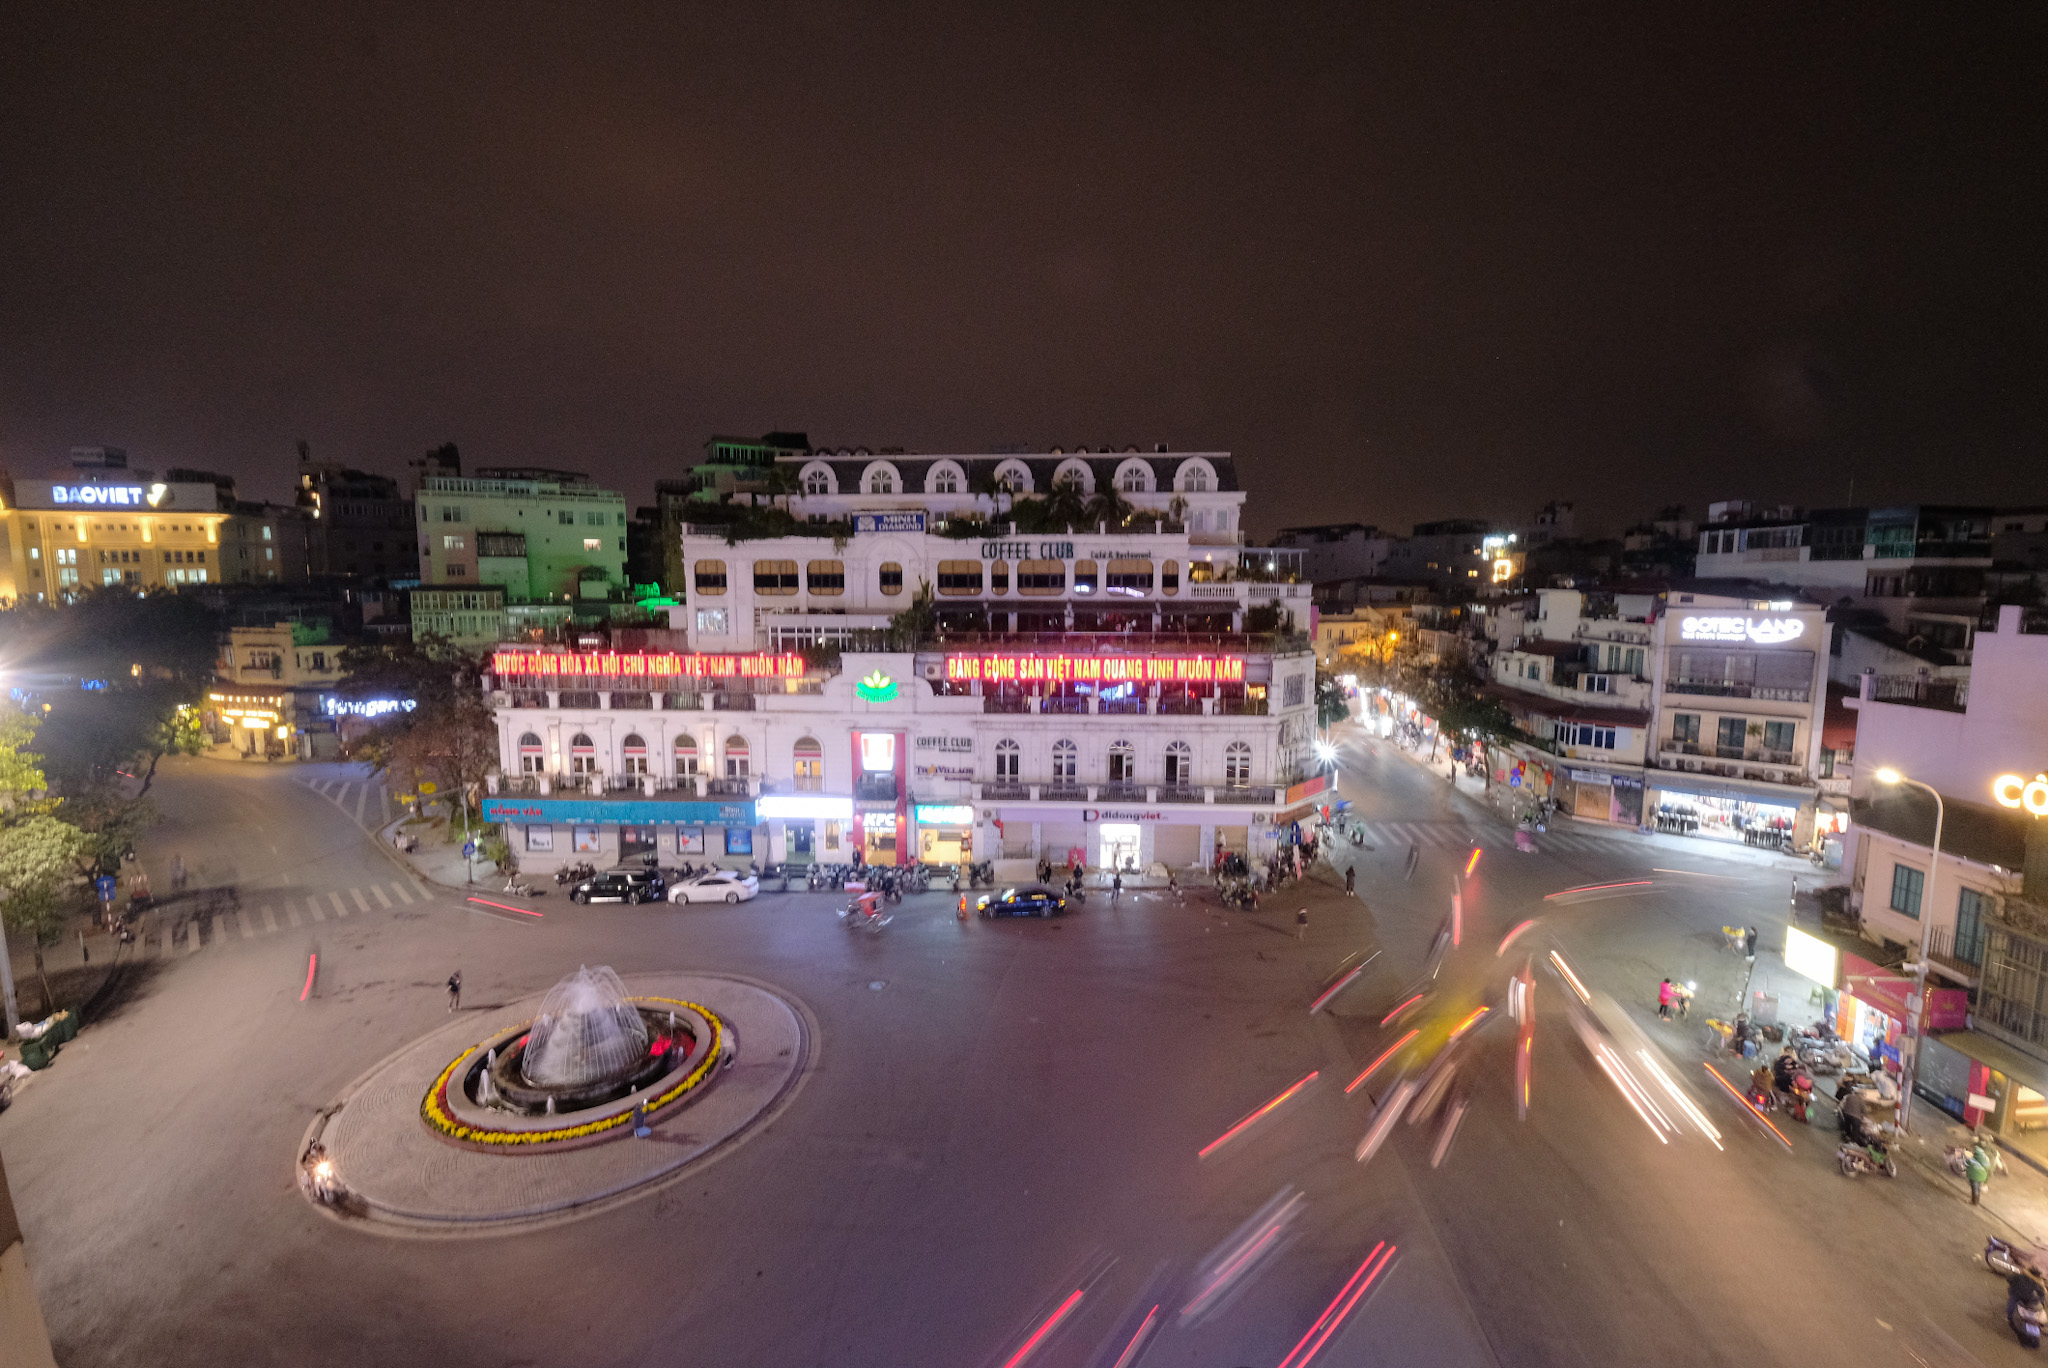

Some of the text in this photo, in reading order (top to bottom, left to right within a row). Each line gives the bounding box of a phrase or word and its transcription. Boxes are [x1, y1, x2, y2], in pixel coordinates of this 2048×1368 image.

[52, 485, 142, 504] BAOVIET
[879, 523, 921, 531] DIAMOND
[883, 515, 917, 523] MINH
[981, 542, 1074, 560] COFFEE CLUB
[1746, 618, 1804, 638] LAND
[495, 650, 803, 680] NƯỚC CỘNG HÒA XÃ HỘI CHỦ NGHĨA VIỆT NAM MUÔN NĂM
[949, 652, 1242, 683] ĐẢNG CỘNG SẢN VIỆT NAM QUANG VINH MUÔN NĂM
[917, 736, 973, 747] COFFEE CLUB
[863, 812, 897, 828] KFC
